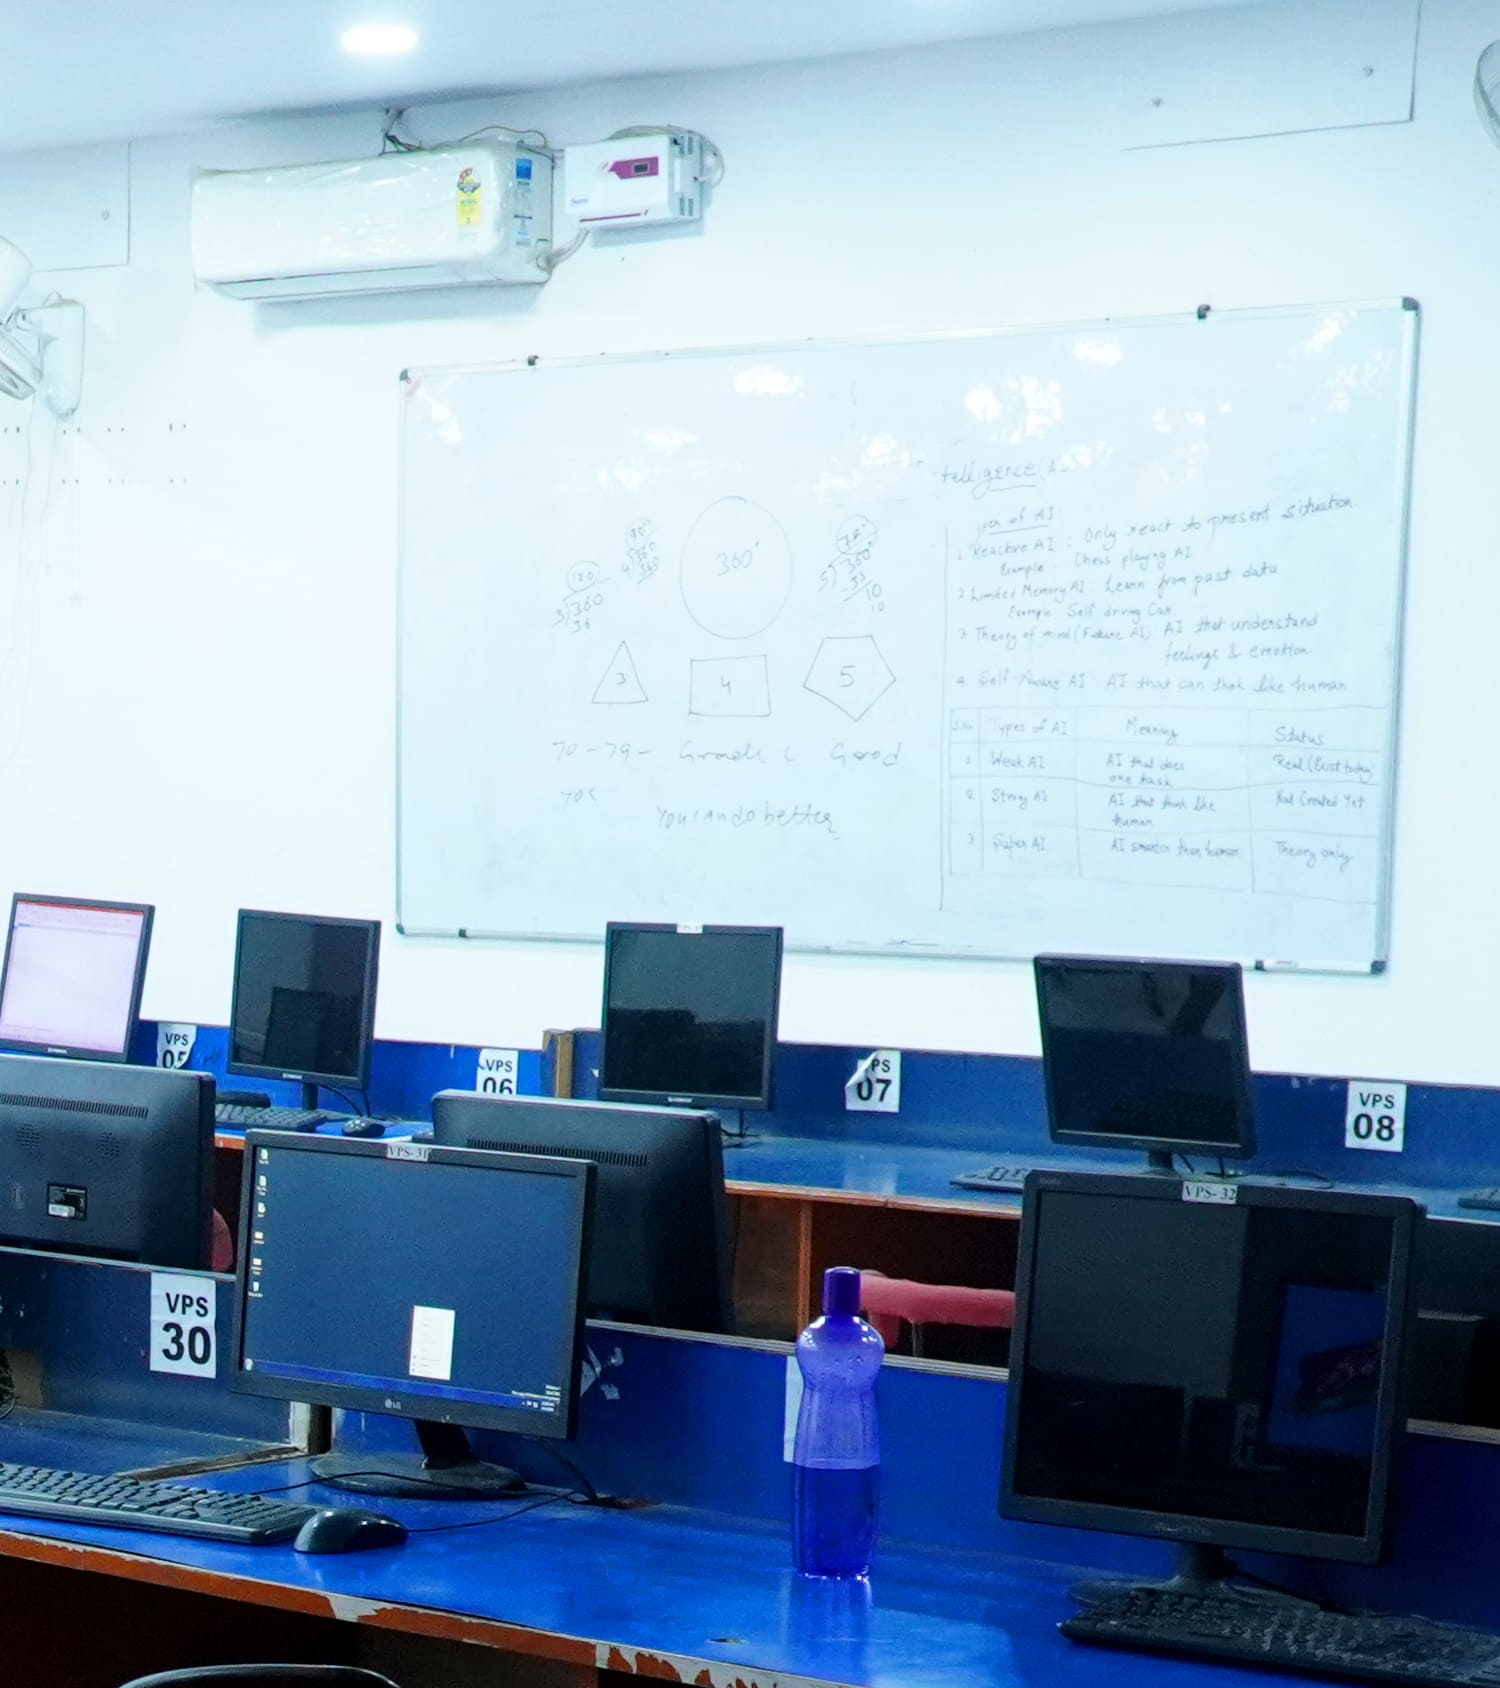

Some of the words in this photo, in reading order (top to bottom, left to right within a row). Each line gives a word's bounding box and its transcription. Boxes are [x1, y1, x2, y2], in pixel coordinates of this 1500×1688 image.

[720, 674, 733, 696] 4
[839, 664, 857, 688] 5
[165, 1032, 189, 1048] VPS
[486, 1058, 514, 1074] VPS
[871, 1058, 892, 1075] PS
[856, 1076, 892, 1104] 07
[1359, 1091, 1396, 1110] VPS
[1352, 1113, 1396, 1143] 08
[164, 1291, 209, 1318] VPS
[161, 1322, 212, 1366] 30
